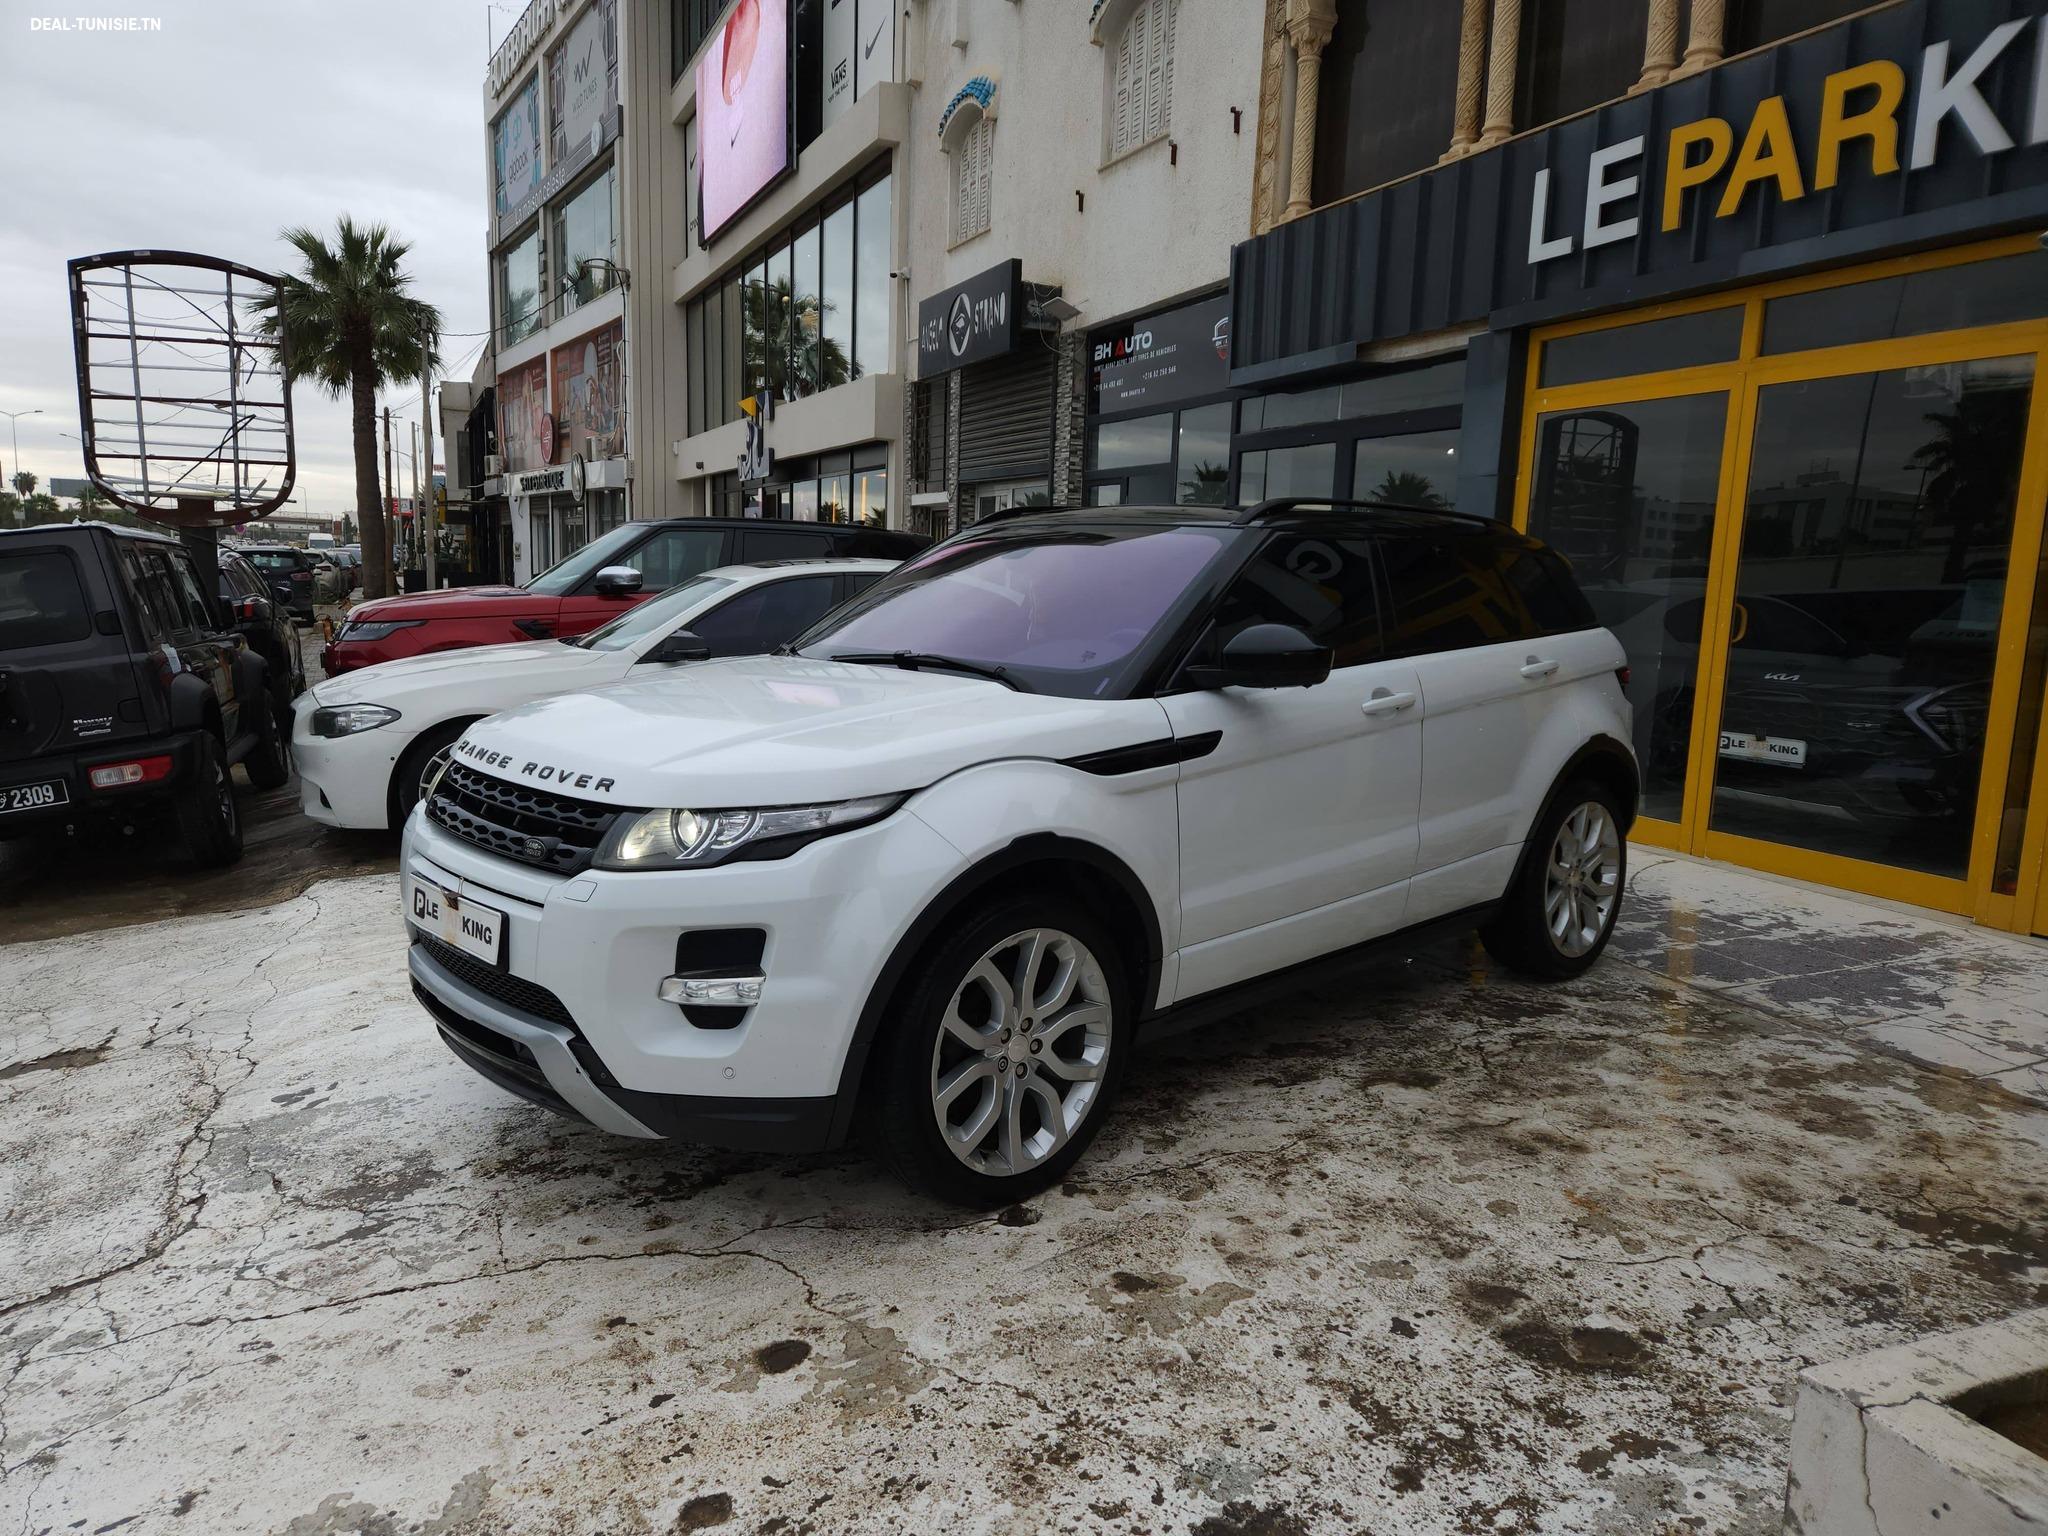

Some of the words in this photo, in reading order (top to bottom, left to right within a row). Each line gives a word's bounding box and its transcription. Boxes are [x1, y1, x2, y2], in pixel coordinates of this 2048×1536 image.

[830, 57, 847, 89] VANS
[1528, 135, 1646, 264] LE
[1094, 341, 1112, 361] BH
[1114, 331, 1153, 357] AUTO
[1732, 739, 1746, 748] LE
[457, 739, 513, 769] RANGE
[521, 761, 616, 792] ROVER
[10, 785, 55, 808] 2309
[425, 901, 439, 921] LE
[462, 915, 492, 945] KING
